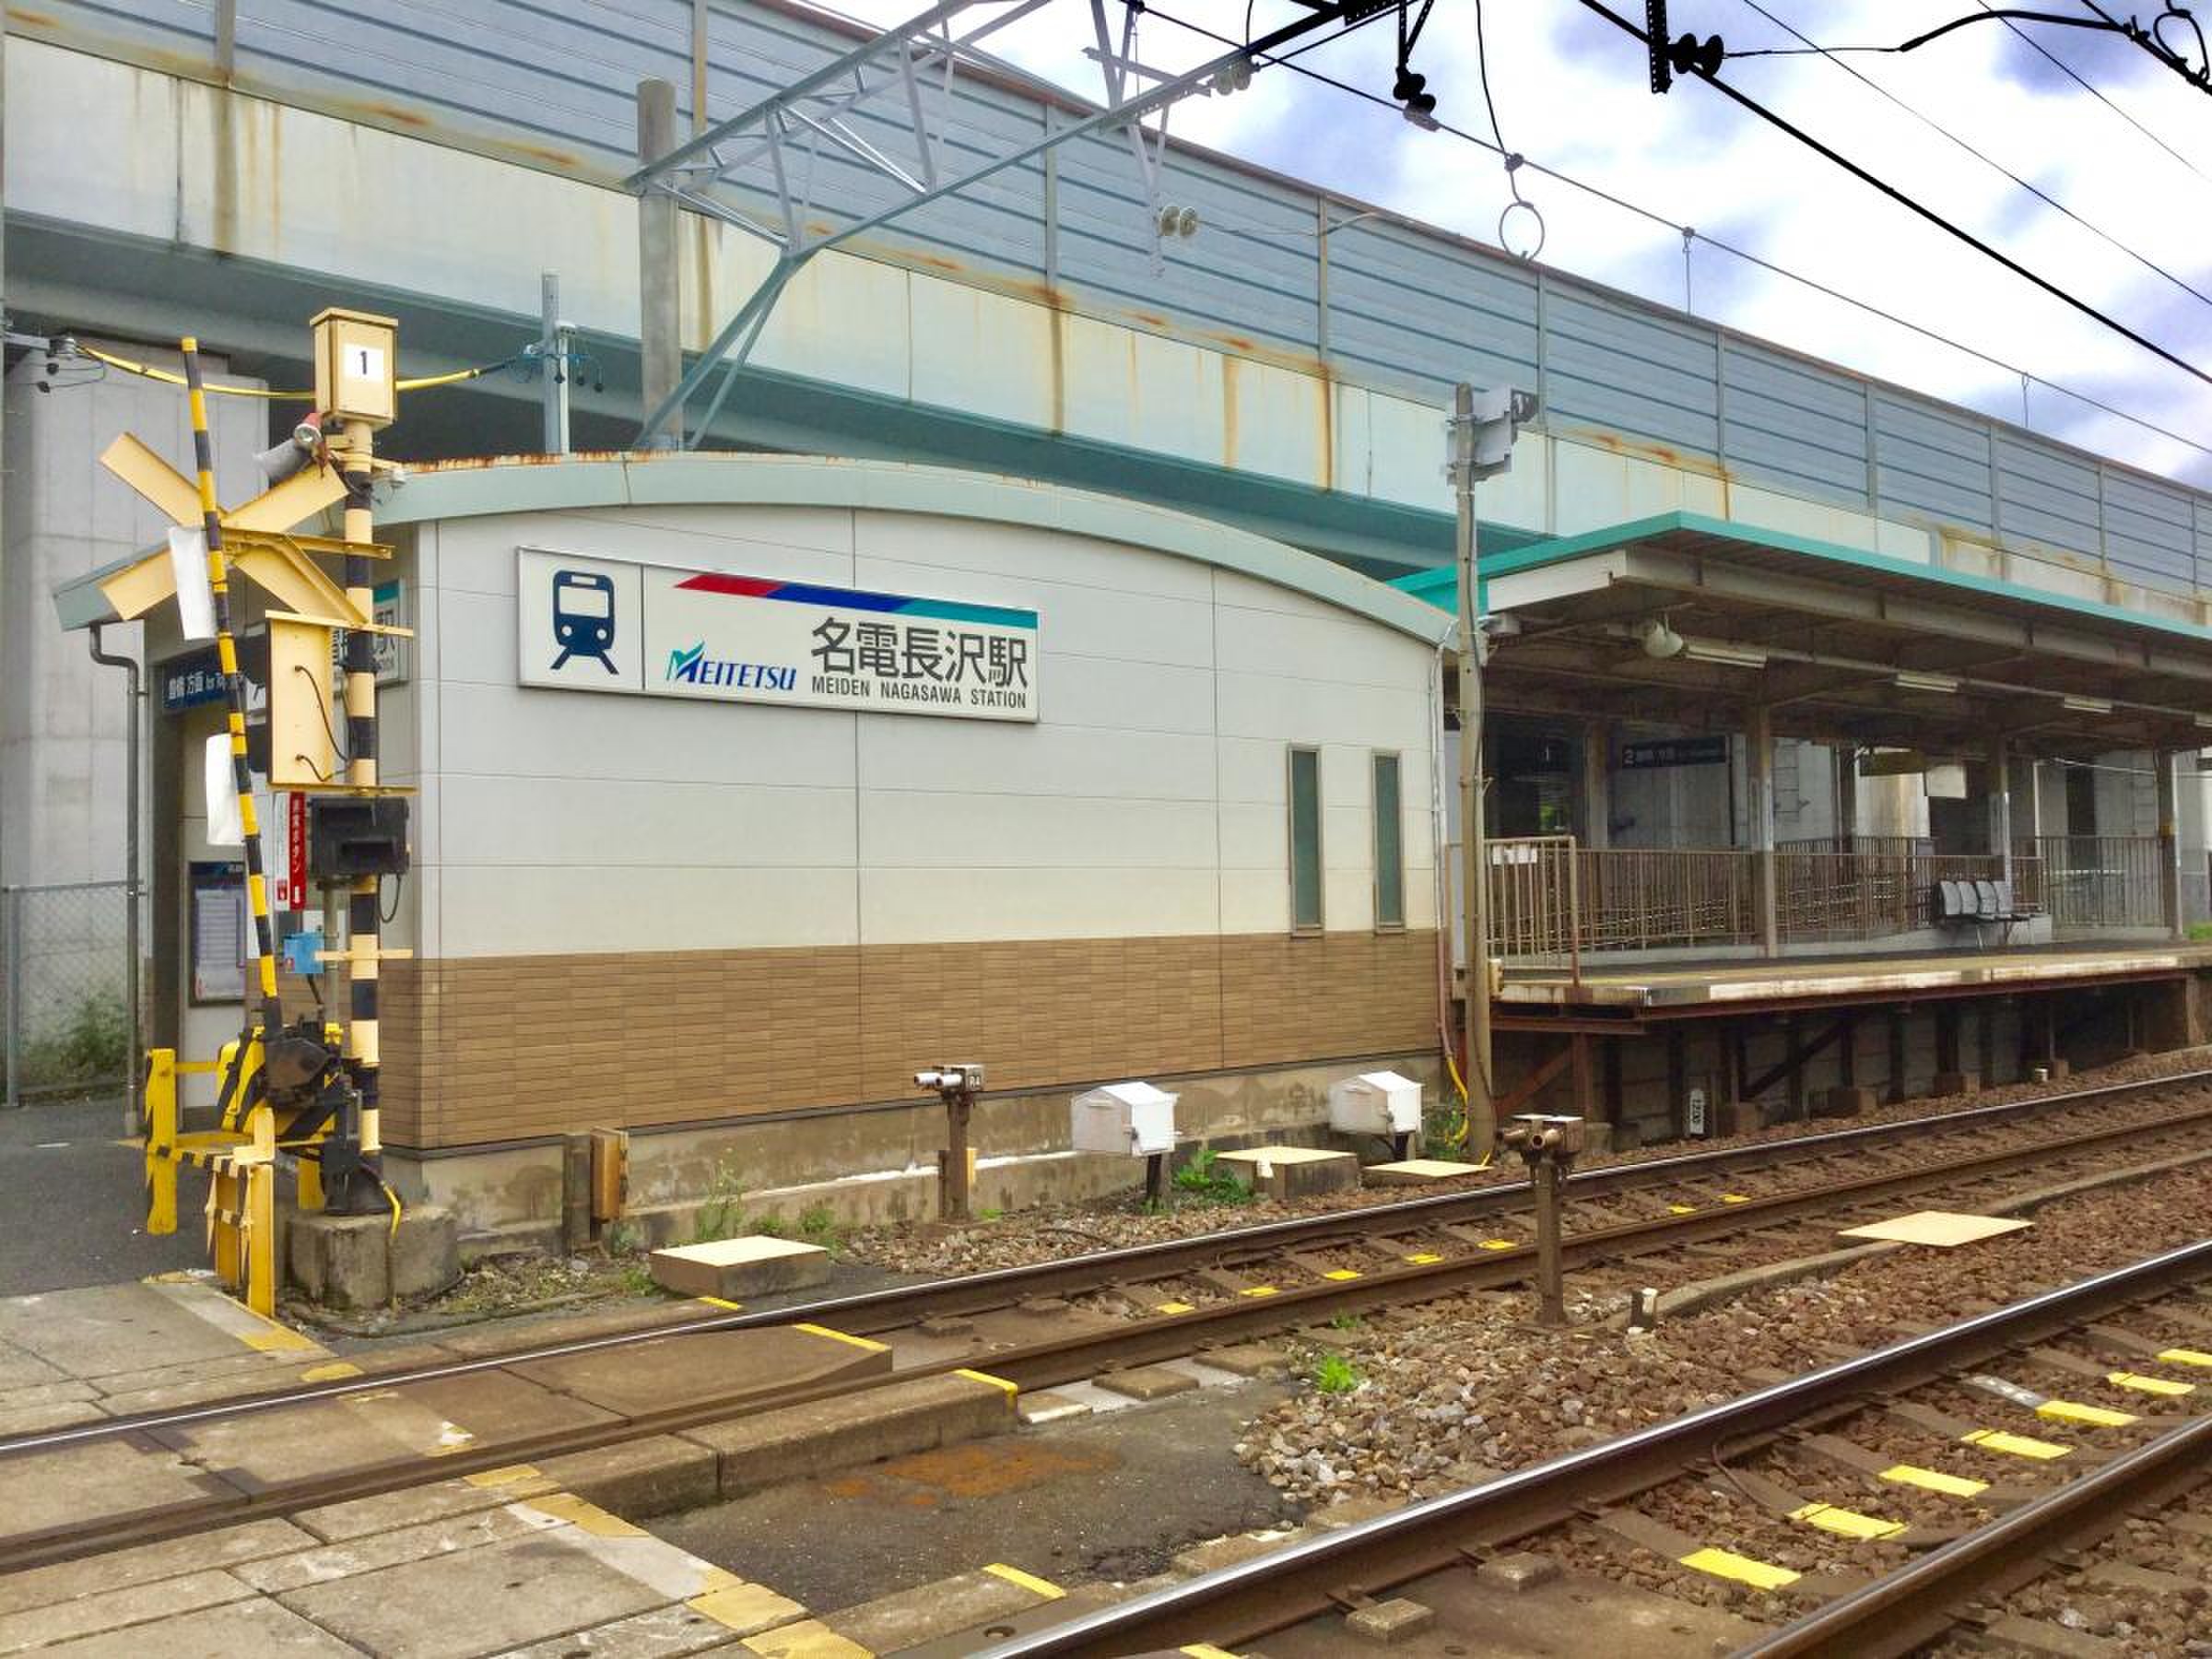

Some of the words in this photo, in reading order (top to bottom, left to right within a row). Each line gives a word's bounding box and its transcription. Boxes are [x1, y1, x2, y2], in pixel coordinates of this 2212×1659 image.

[360, 350, 368, 375] 1
[665, 641, 796, 690] MEITETSU
[811, 618, 1028, 688] 名電長沢駅
[812, 676, 871, 697] MEIDEN
[880, 682, 962, 704] NAGASAWA
[971, 688, 1027, 709] STATION
